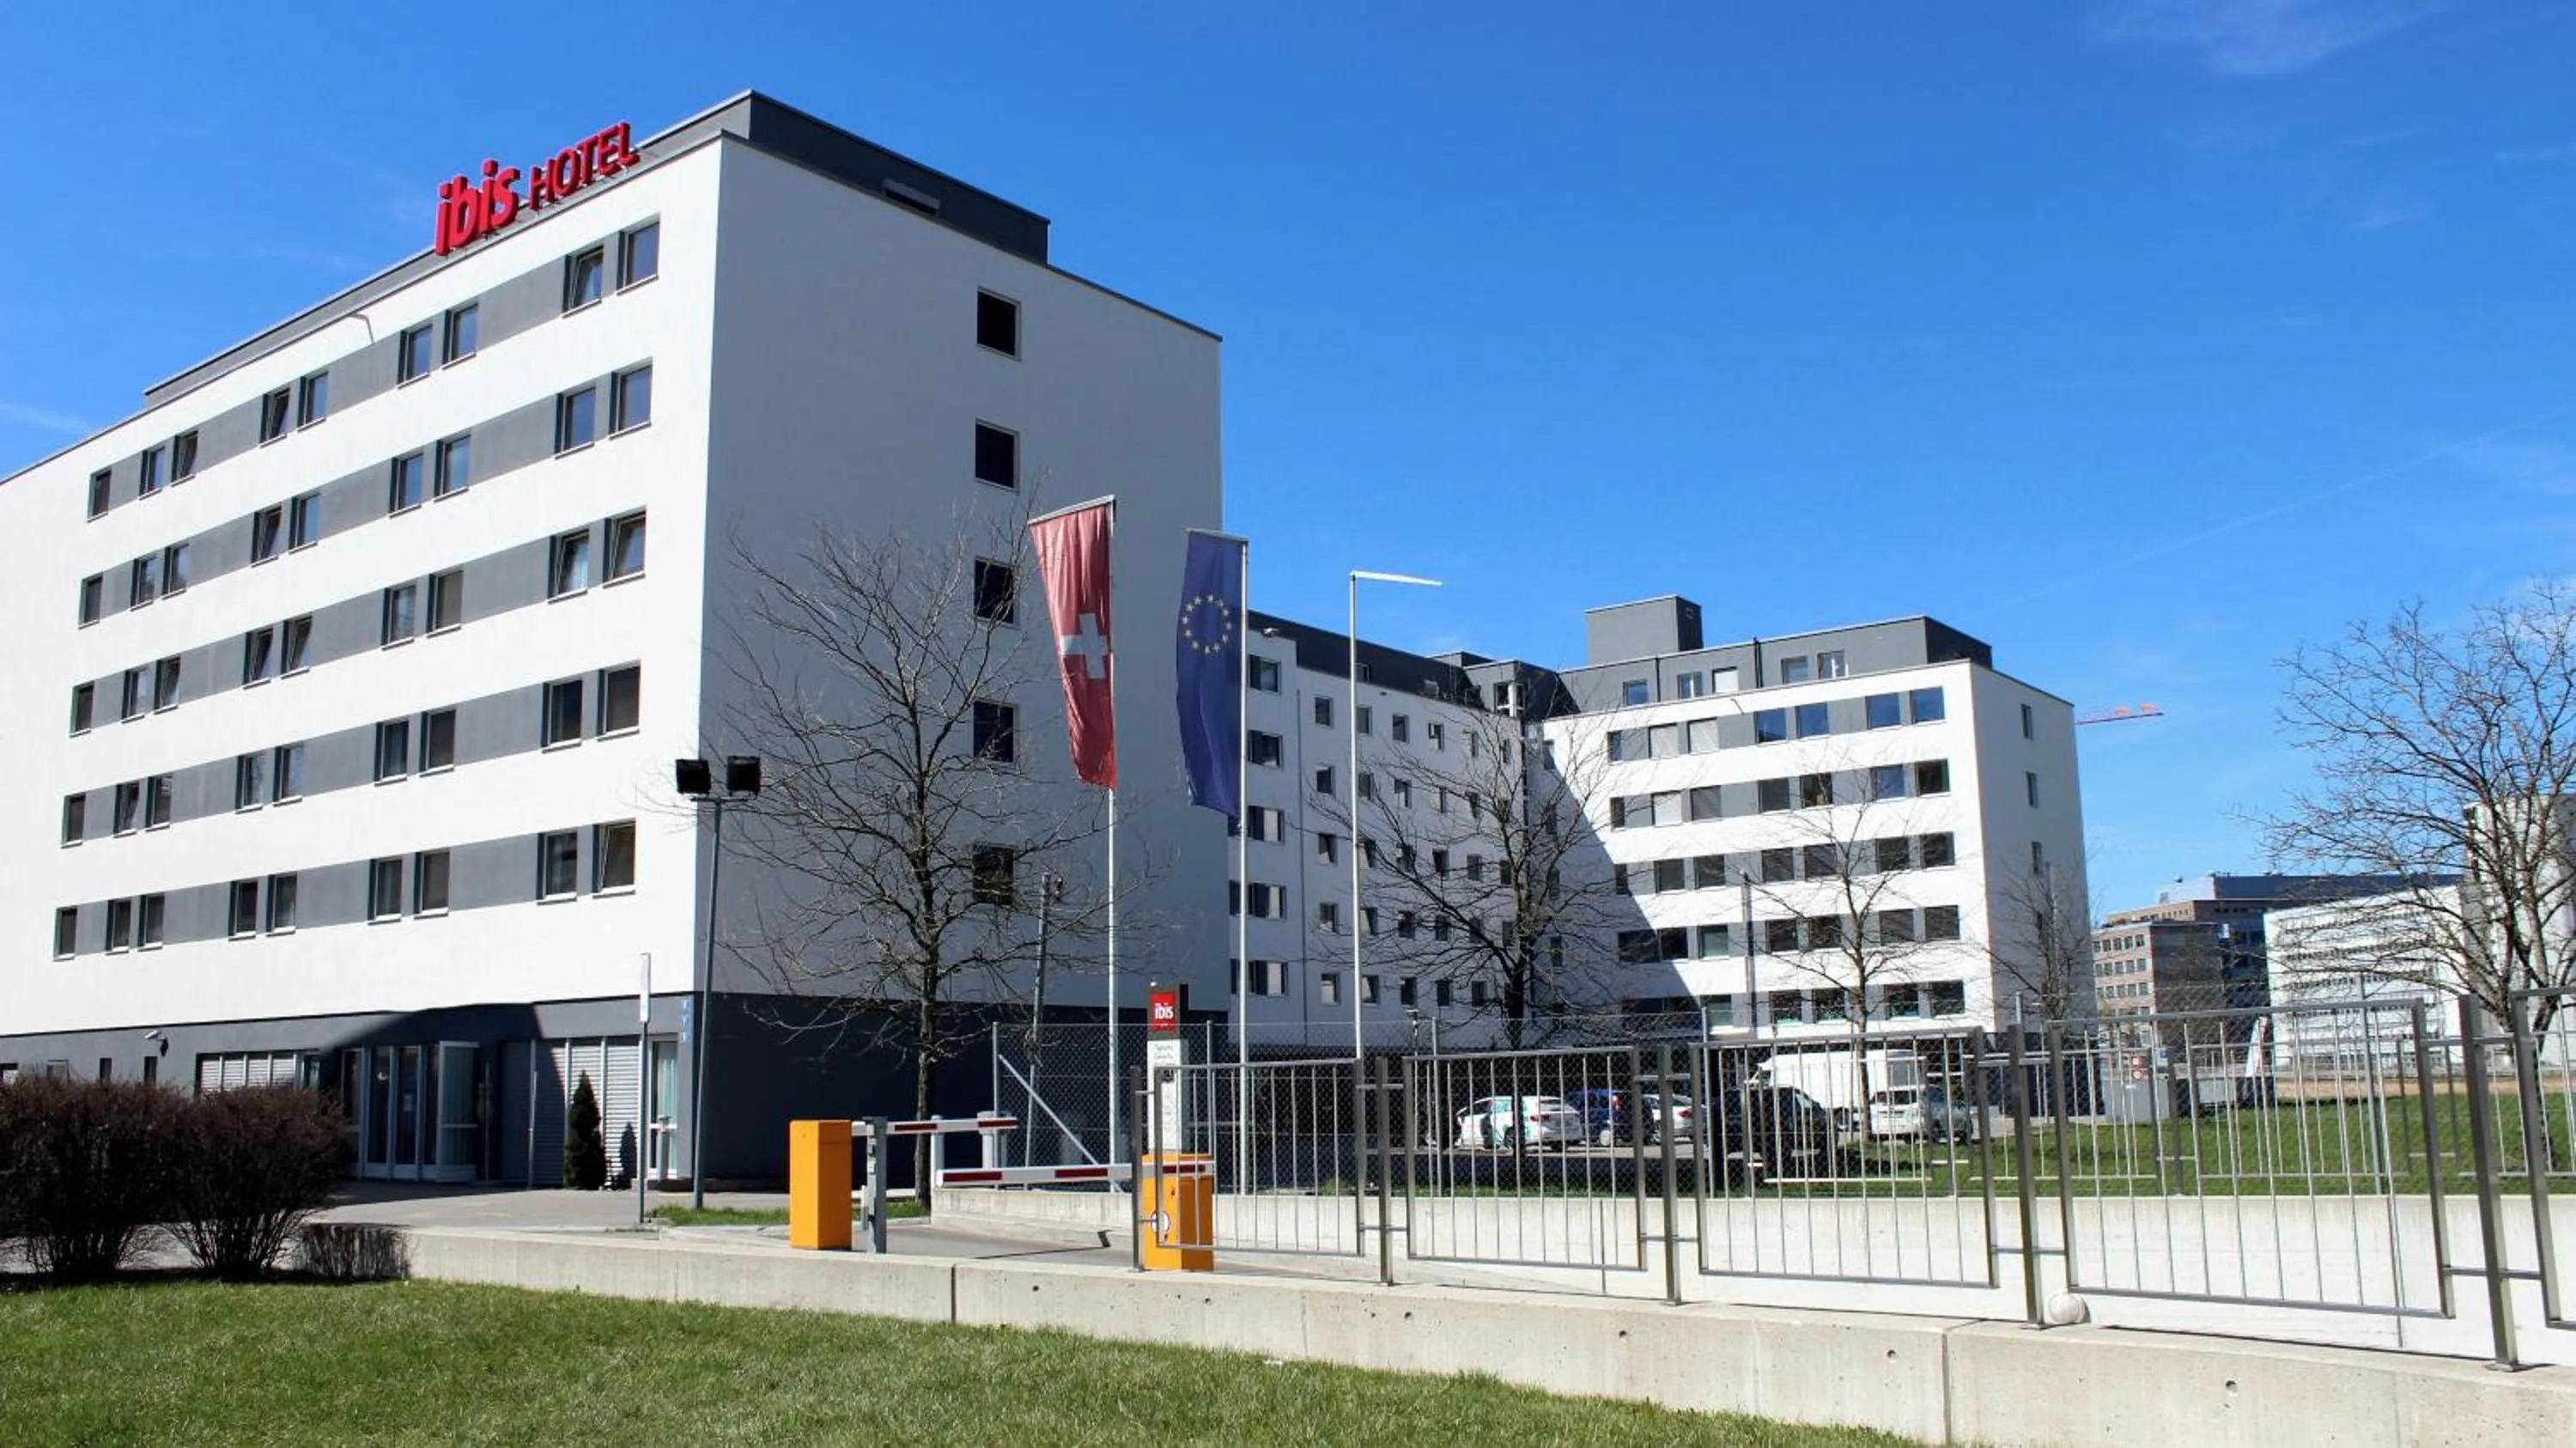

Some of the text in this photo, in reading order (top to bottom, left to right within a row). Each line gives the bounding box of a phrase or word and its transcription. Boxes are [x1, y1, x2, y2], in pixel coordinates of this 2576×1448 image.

[434, 120, 641, 256] ibis HOTEL
[1154, 1002, 1174, 1019] ibis
